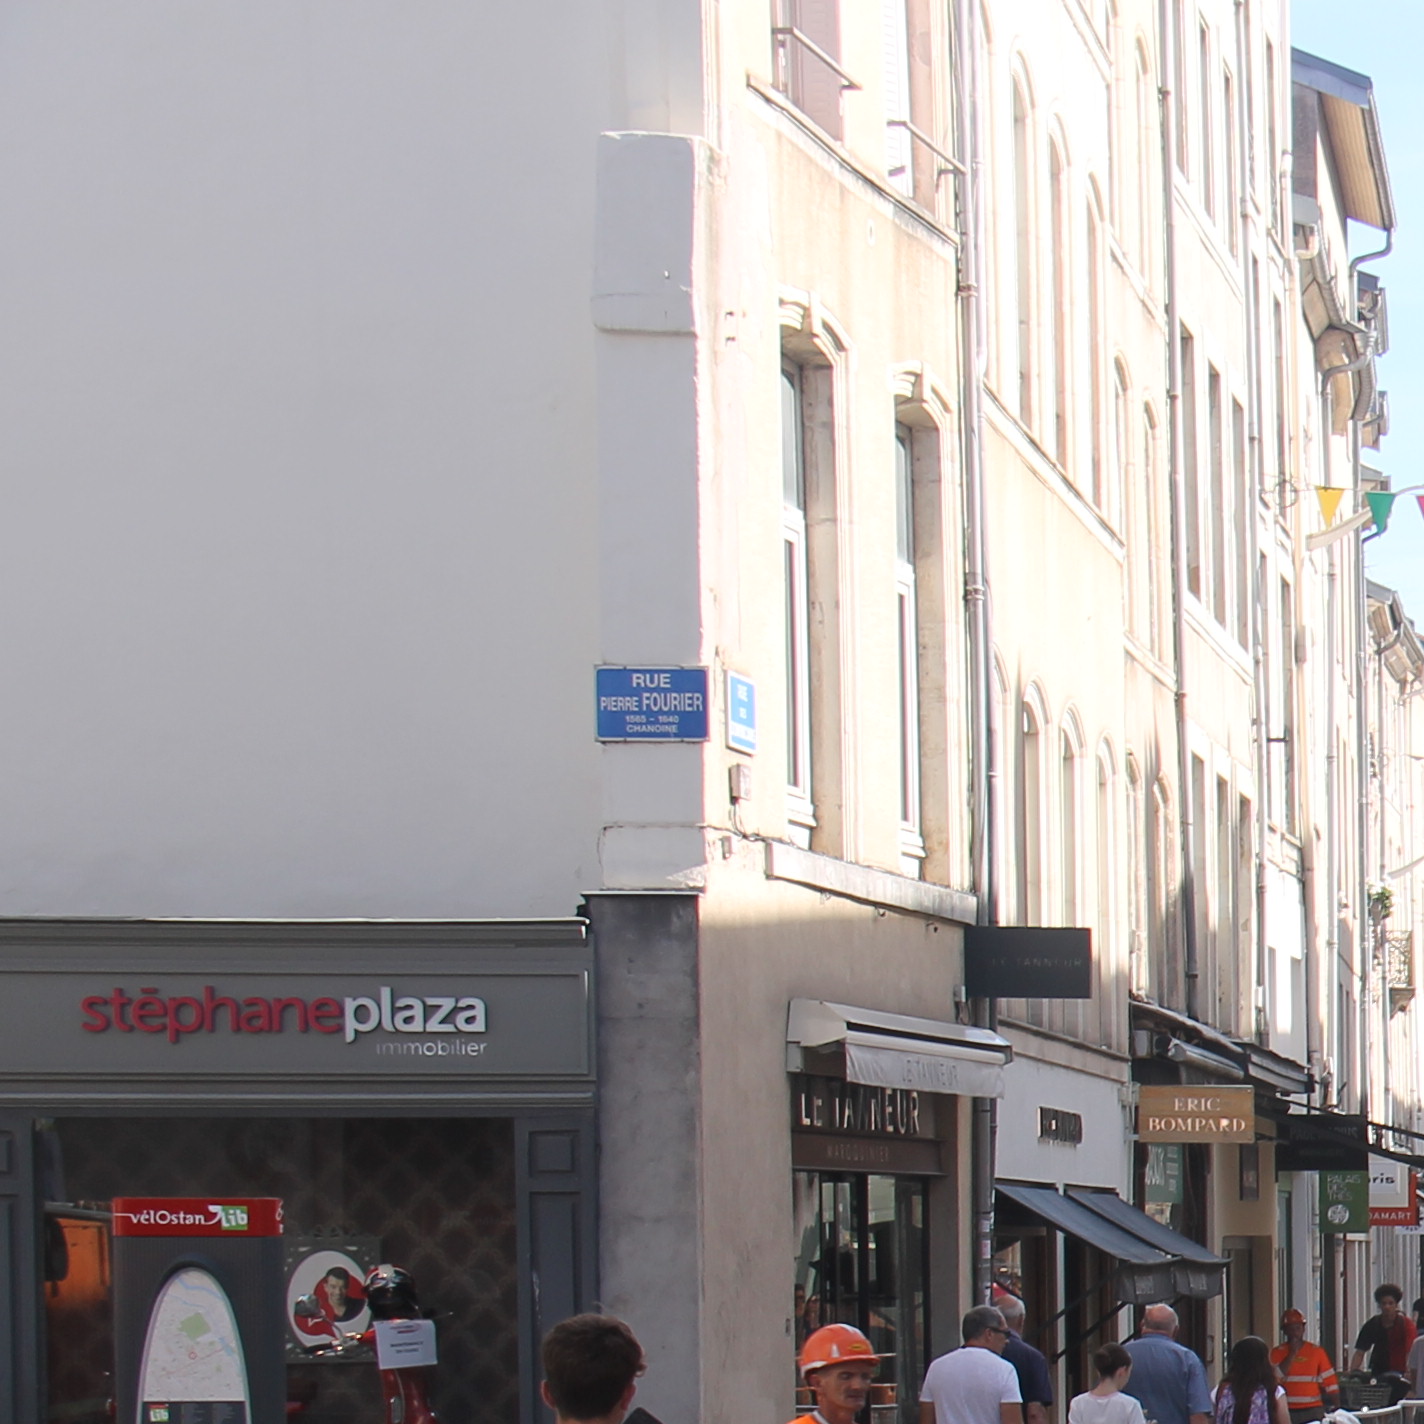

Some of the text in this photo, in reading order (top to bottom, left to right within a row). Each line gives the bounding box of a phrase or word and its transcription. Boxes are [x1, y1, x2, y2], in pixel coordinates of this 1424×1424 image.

[632, 673, 671, 688] RUE
[600, 692, 703, 712] PIERRE FOURIER
[626, 724, 678, 733] CHANOINE
[375, 1040, 488, 1057] immobilier
[800, 1092, 823, 1127] LE
[1174, 1097, 1221, 1112] ERIC
[1148, 1117, 1246, 1132] BOMPARD
